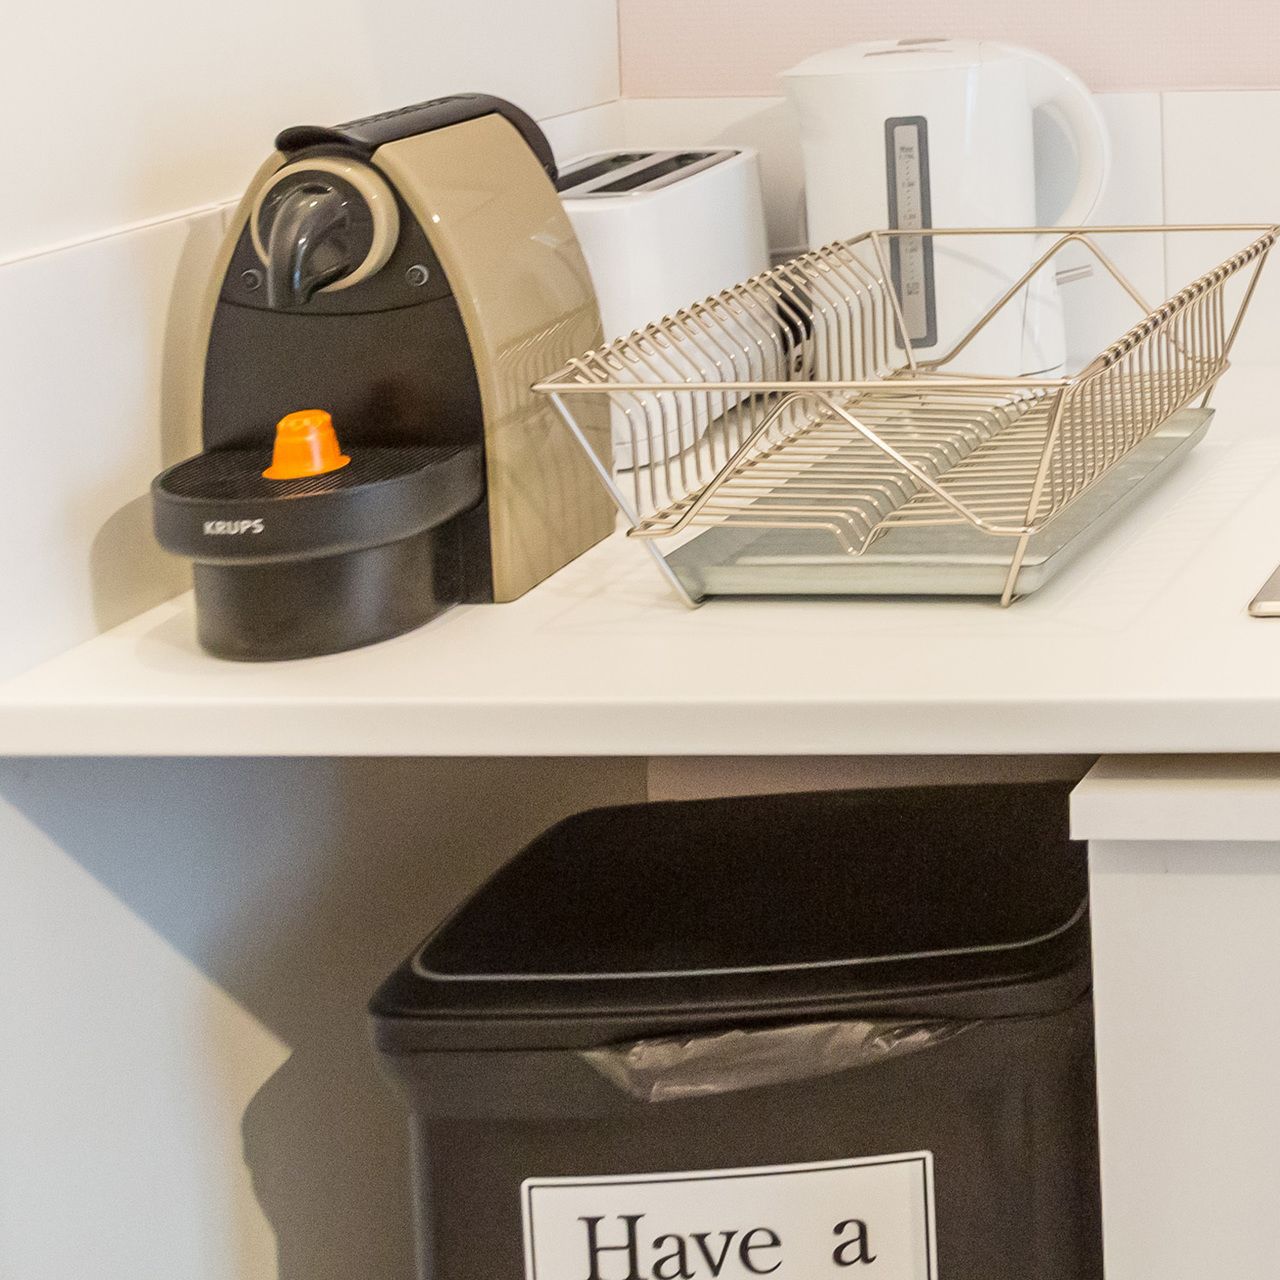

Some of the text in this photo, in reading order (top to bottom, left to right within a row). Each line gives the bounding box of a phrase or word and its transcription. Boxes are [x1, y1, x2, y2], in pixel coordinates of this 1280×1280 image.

[203, 518, 265, 535] KRUPS
[577, 1213, 878, 1280] Have a
